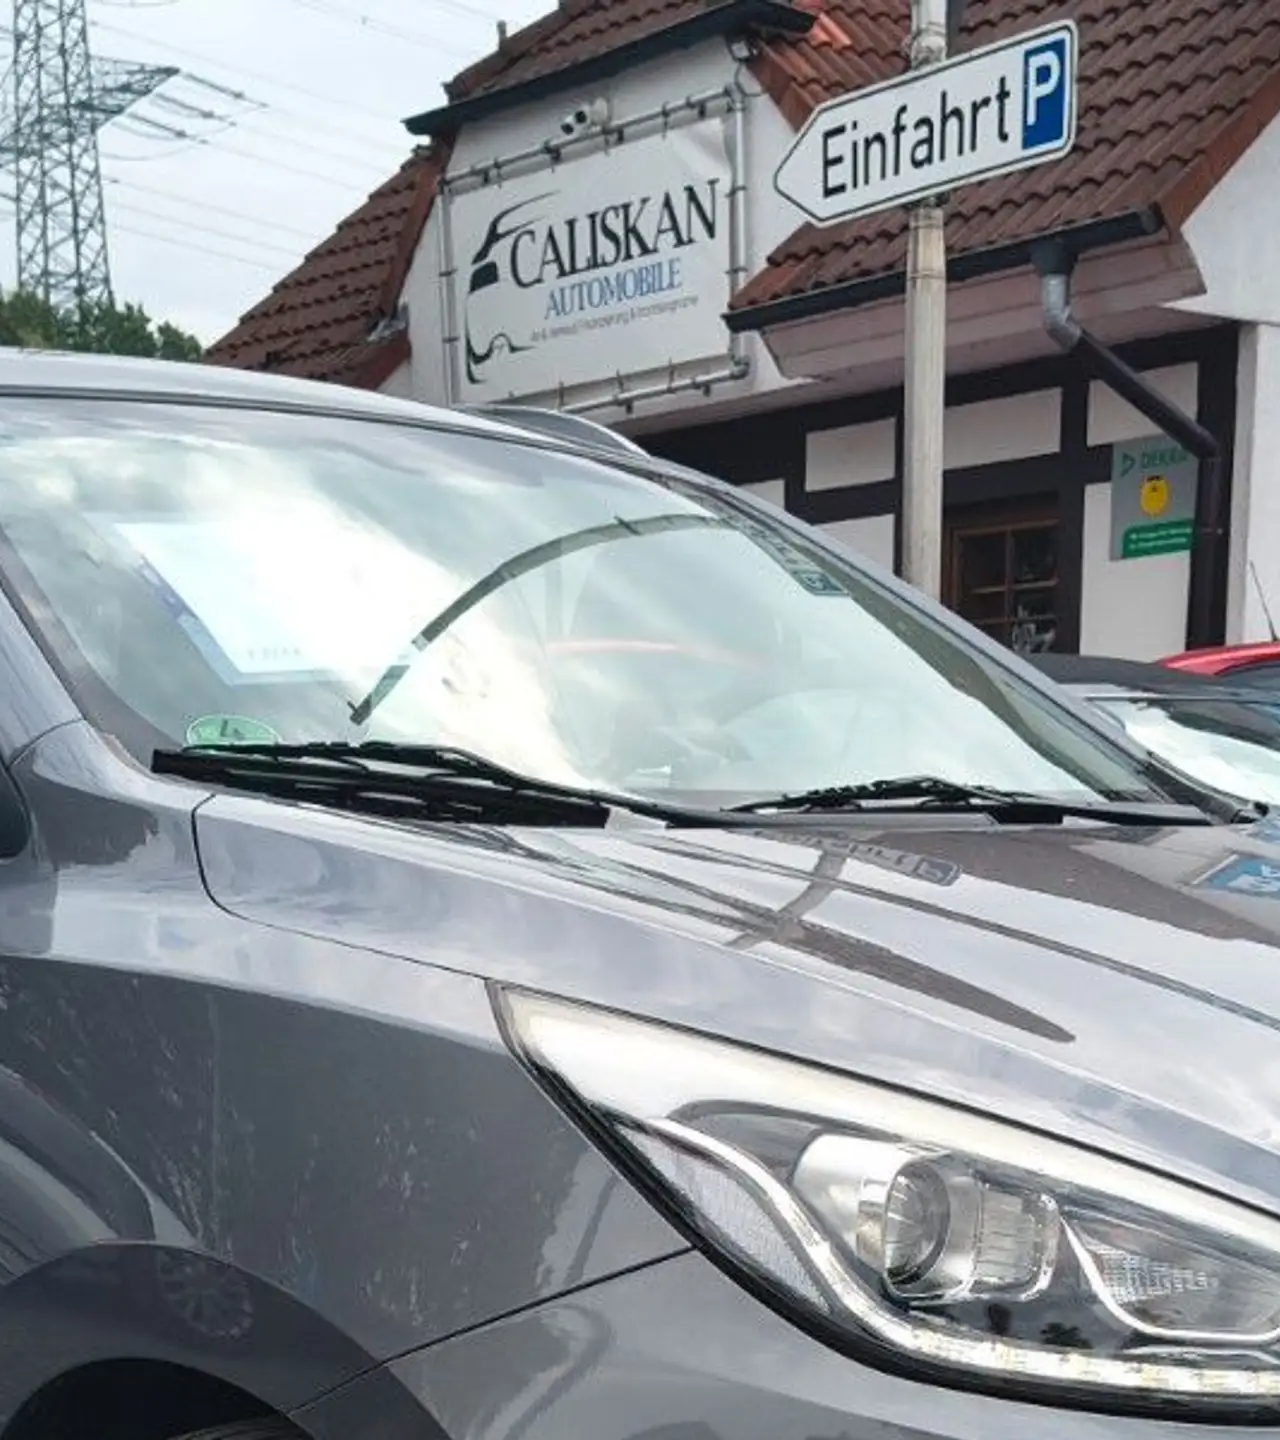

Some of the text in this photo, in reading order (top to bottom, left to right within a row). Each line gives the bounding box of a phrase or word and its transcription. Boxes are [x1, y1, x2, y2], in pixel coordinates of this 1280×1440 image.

[821, 50, 1062, 199] Einfahrt P
[509, 178, 720, 289] CALISKAN
[544, 257, 683, 320] AUTOMOBILE
